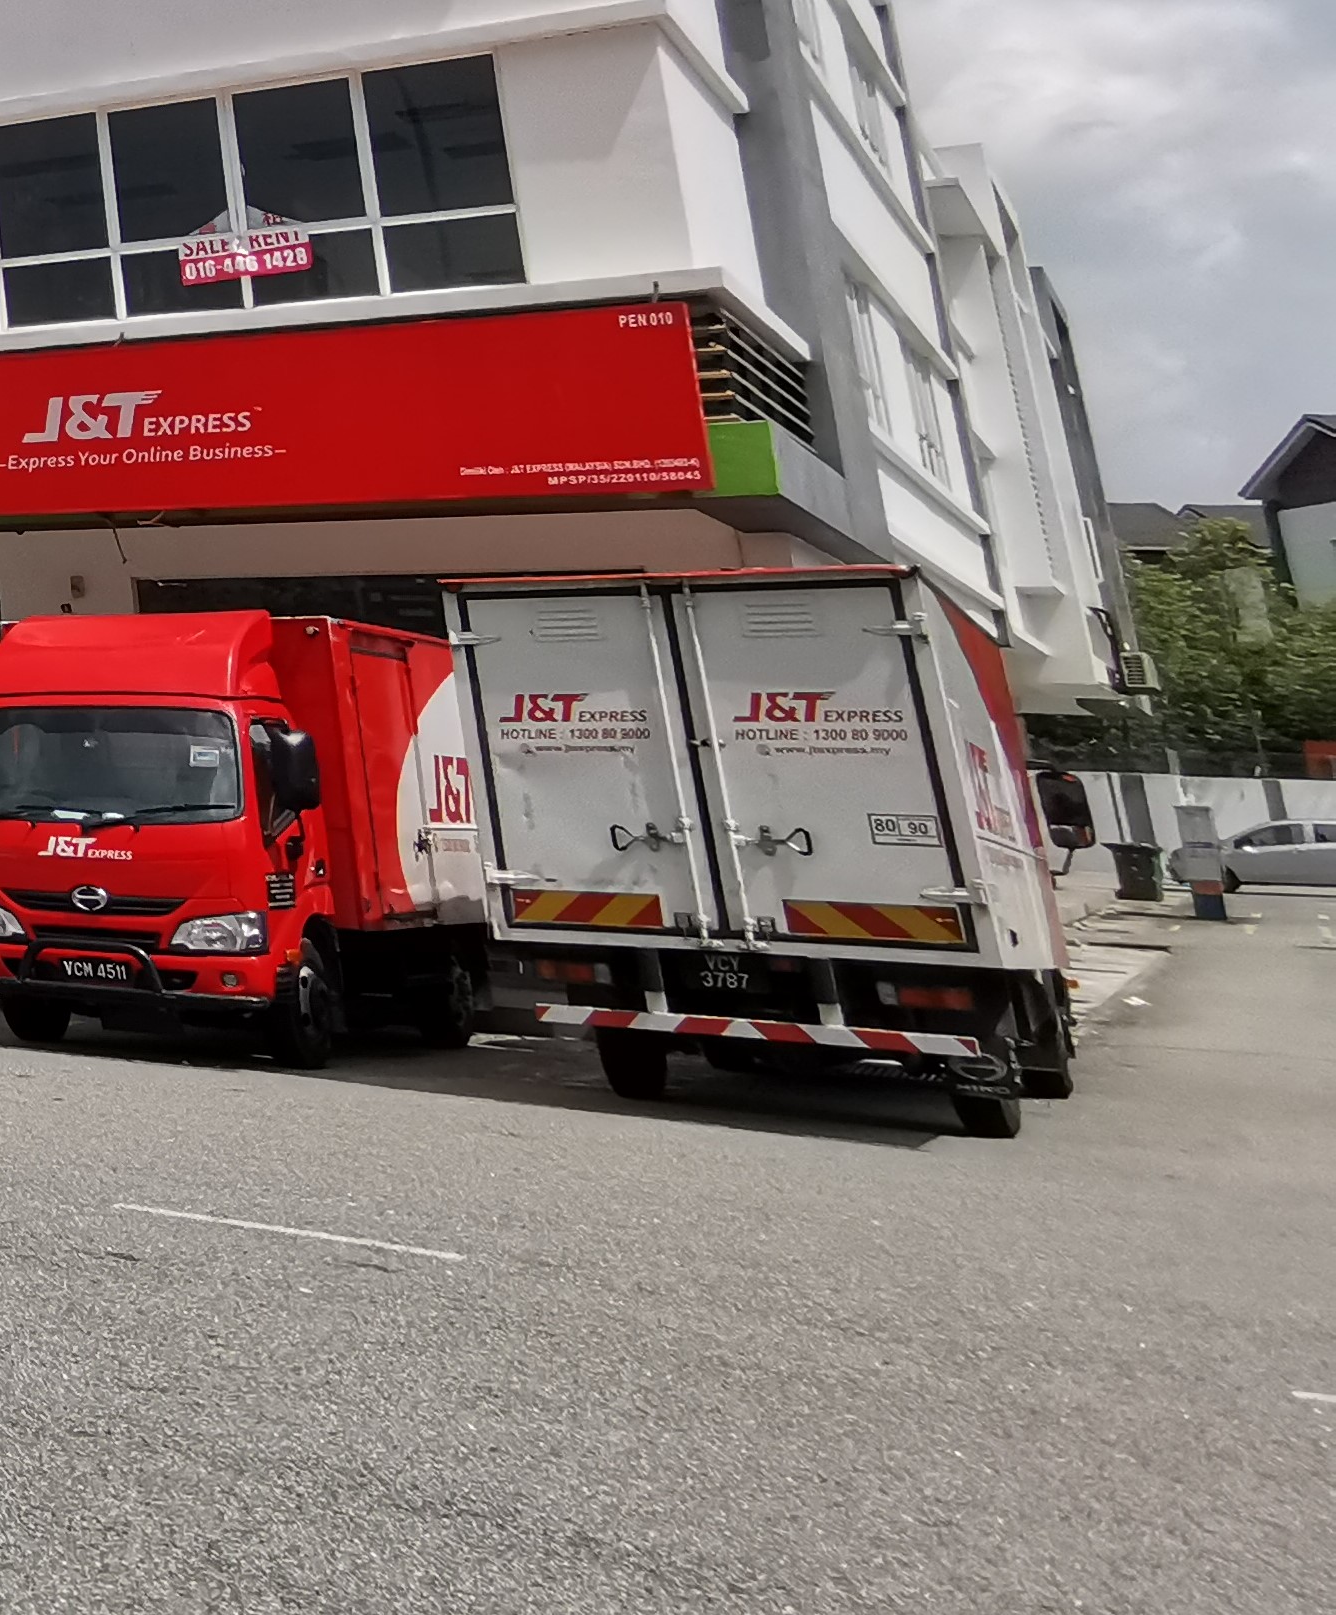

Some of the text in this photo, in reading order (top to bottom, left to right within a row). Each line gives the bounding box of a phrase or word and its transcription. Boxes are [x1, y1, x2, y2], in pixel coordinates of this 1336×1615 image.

[618, 311, 674, 328] PEN 010
[22, 390, 252, 443] J&T EXPRESS
[78, 450, 119, 467] Your
[122, 446, 184, 464] Online
[526, 462, 564, 474] EXPRESS
[499, 693, 647, 723] J&T EXPRESS
[733, 691, 904, 723] J&T EXPRESS
[501, 729, 556, 740] HOTLINE
[569, 729, 598, 740] 1300
[735, 729, 908, 741] HOTLINE 1300 80 9000
[429, 755, 471, 823] J&T
[873, 818, 896, 832] 80
[907, 821, 928, 834] 90
[38, 836, 133, 860] J&T EXPRESS
[63, 960, 127, 980] VCM 4511
[704, 954, 739, 971] VCY
[700, 971, 748, 989] 3787
